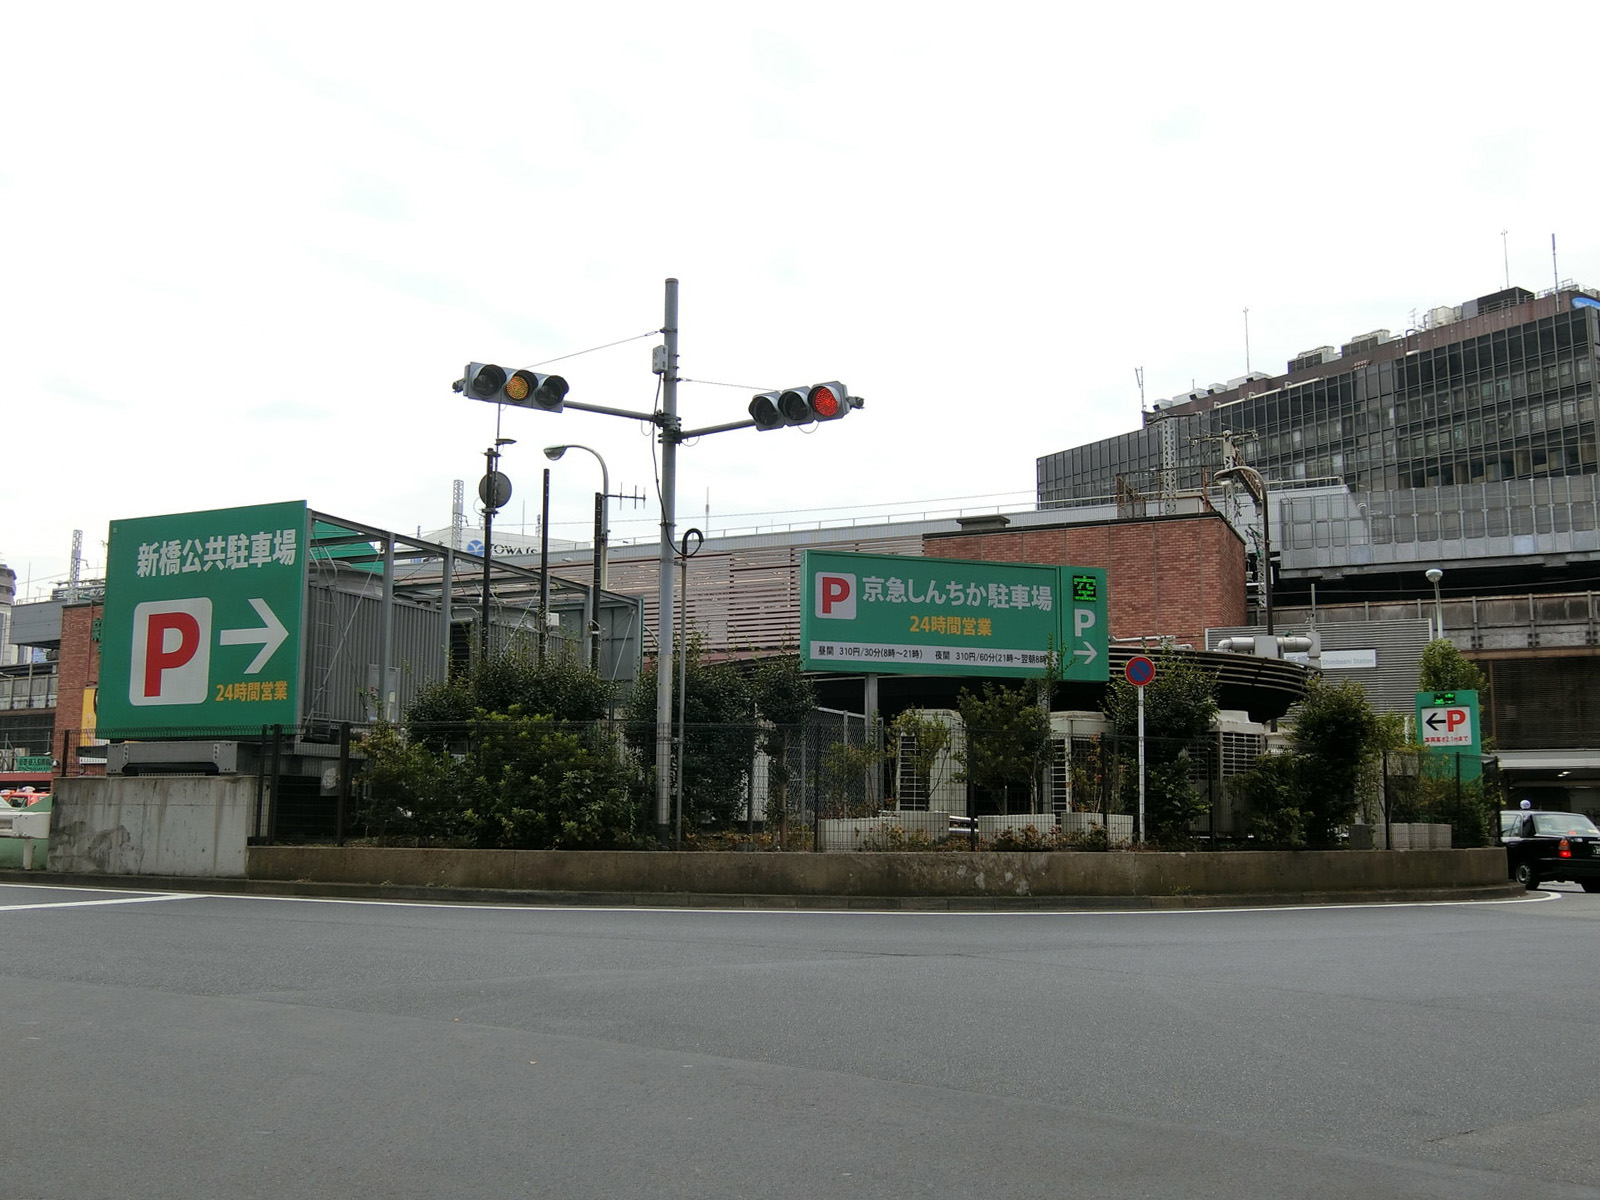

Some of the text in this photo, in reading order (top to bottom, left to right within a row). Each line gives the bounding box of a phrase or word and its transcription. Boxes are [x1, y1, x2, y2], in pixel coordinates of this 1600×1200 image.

[136, 528, 297, 578] 新橋公共駐車場
[822, 576, 851, 614] P
[862, 575, 1053, 612] 京急しんちか駐車場
[909, 614, 993, 637] 24時間営業
[1074, 608, 1096, 637] P
[143, 612, 201, 697] P
[817, 645, 834, 656] 昼間
[934, 650, 950, 661] 夜間
[1321, 657, 1374, 666] Shimbashi Station
[215, 680, 288, 703] 24時間営業
[1446, 709, 1466, 732] P
